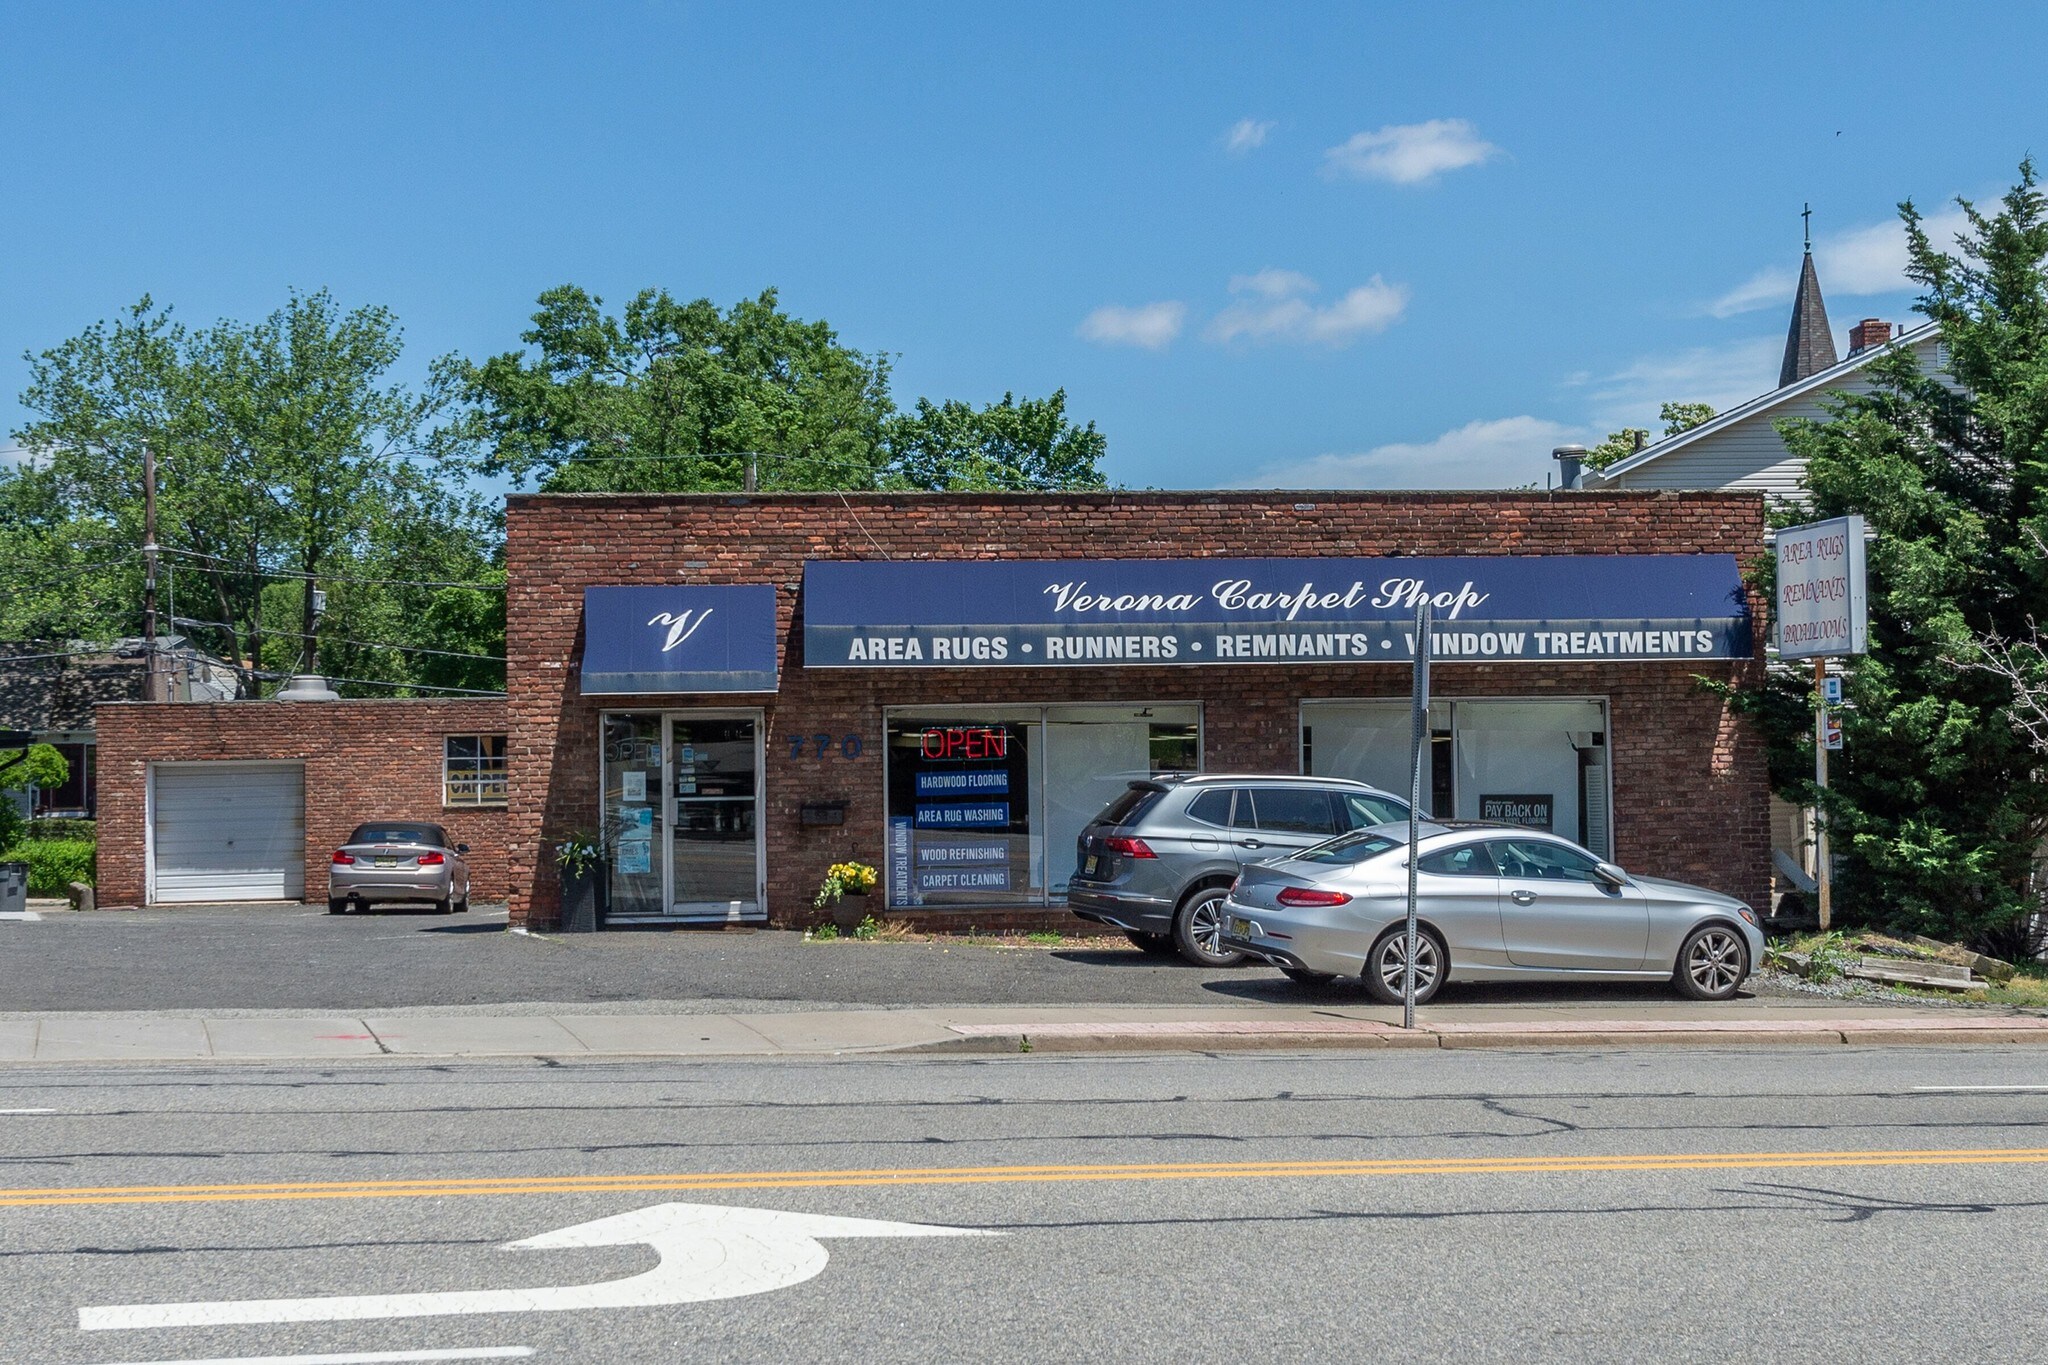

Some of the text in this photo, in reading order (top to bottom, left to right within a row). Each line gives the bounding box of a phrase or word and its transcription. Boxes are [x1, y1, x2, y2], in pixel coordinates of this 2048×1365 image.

[1782, 535, 1844, 565] AREA RUGS
[1043, 577, 1490, 621] Verona Carpet Shop
[1783, 576, 1845, 606] REMNANTS
[647, 608, 714, 652] V
[848, 637, 924, 660] AREA
[932, 637, 1008, 660] RUGS
[1046, 635, 1178, 660] RUNNERS
[1216, 633, 1368, 658] REMNANTS
[1534, 630, 1713, 654] TREATMENTS
[1784, 616, 1847, 646] BROADLOOMS
[787, 734, 863, 762] 770
[923, 729, 1004, 759] OPEN
[921, 773, 1007, 789] HARDWOOD FLOORING
[918, 808, 1004, 822] AREA RUG WASHING
[1485, 804, 1547, 817] PAY BACK ON
[895, 822, 908, 906] WINDOW TREATMENTS
[921, 847, 1005, 861] WOOD REFINISHING
[922, 873, 1005, 887] CARPET CLEANING
